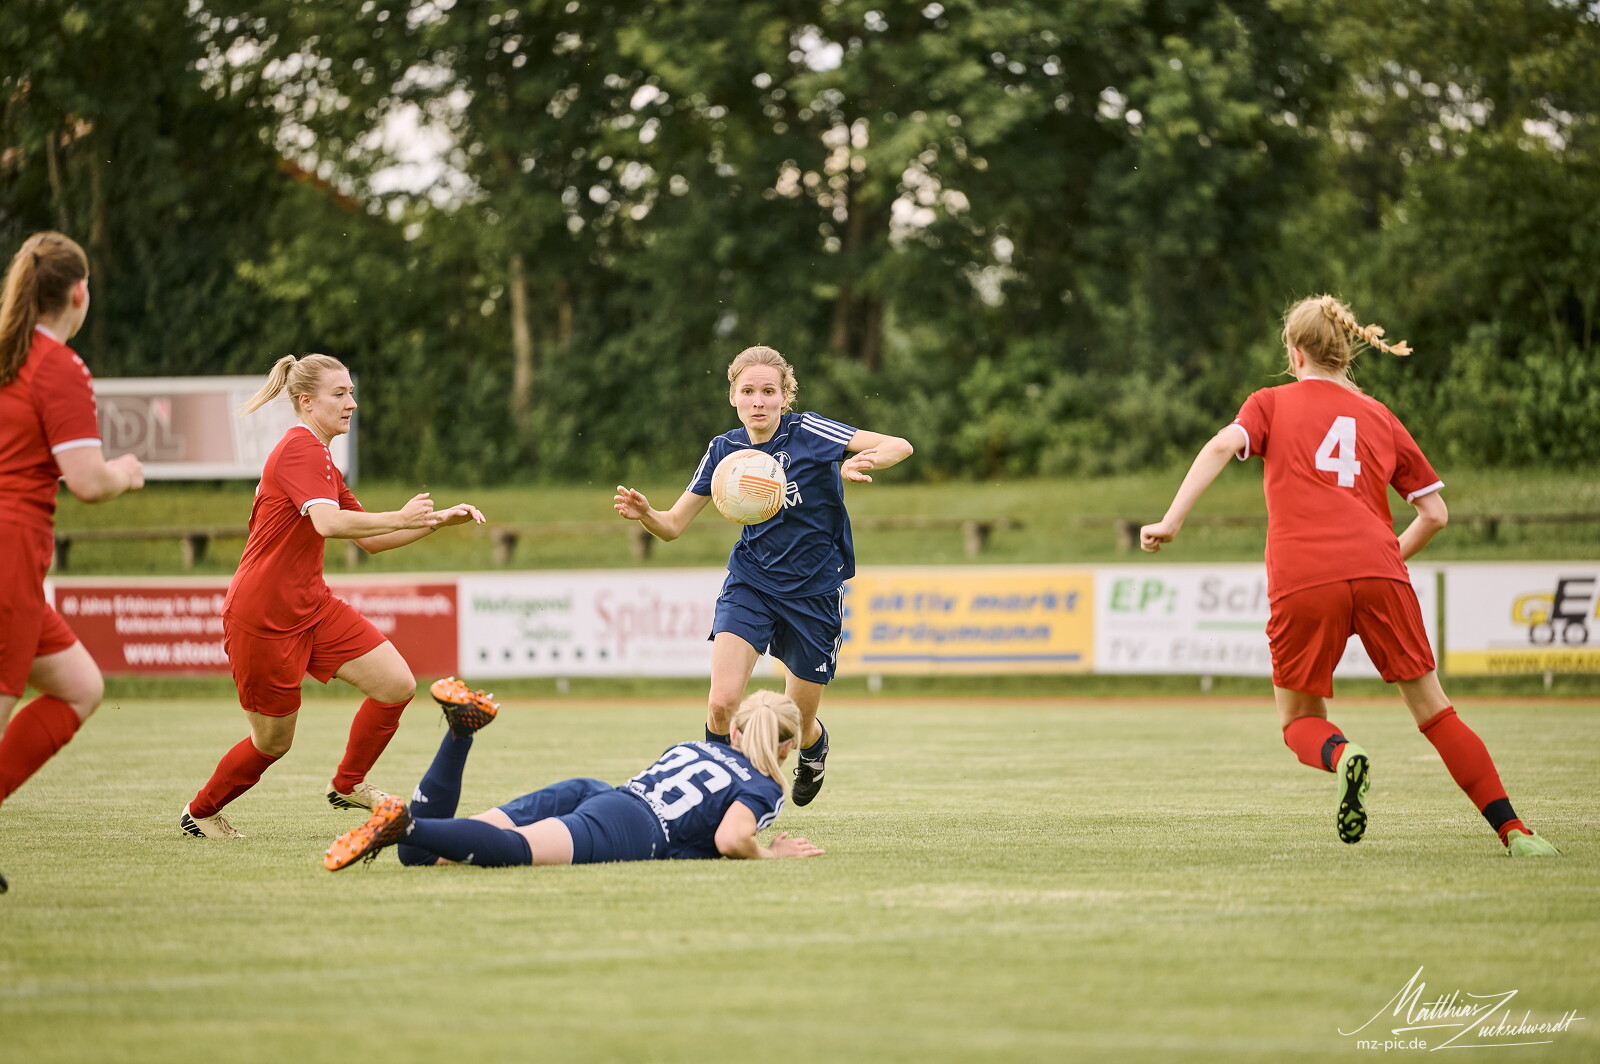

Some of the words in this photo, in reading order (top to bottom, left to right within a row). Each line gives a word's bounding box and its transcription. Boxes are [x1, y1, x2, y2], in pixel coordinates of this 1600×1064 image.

[1315, 415, 1361, 488] 4
[970, 590, 1079, 613] markt
[1108, 576, 1178, 613] EP:
[625, 745, 732, 821] 26
